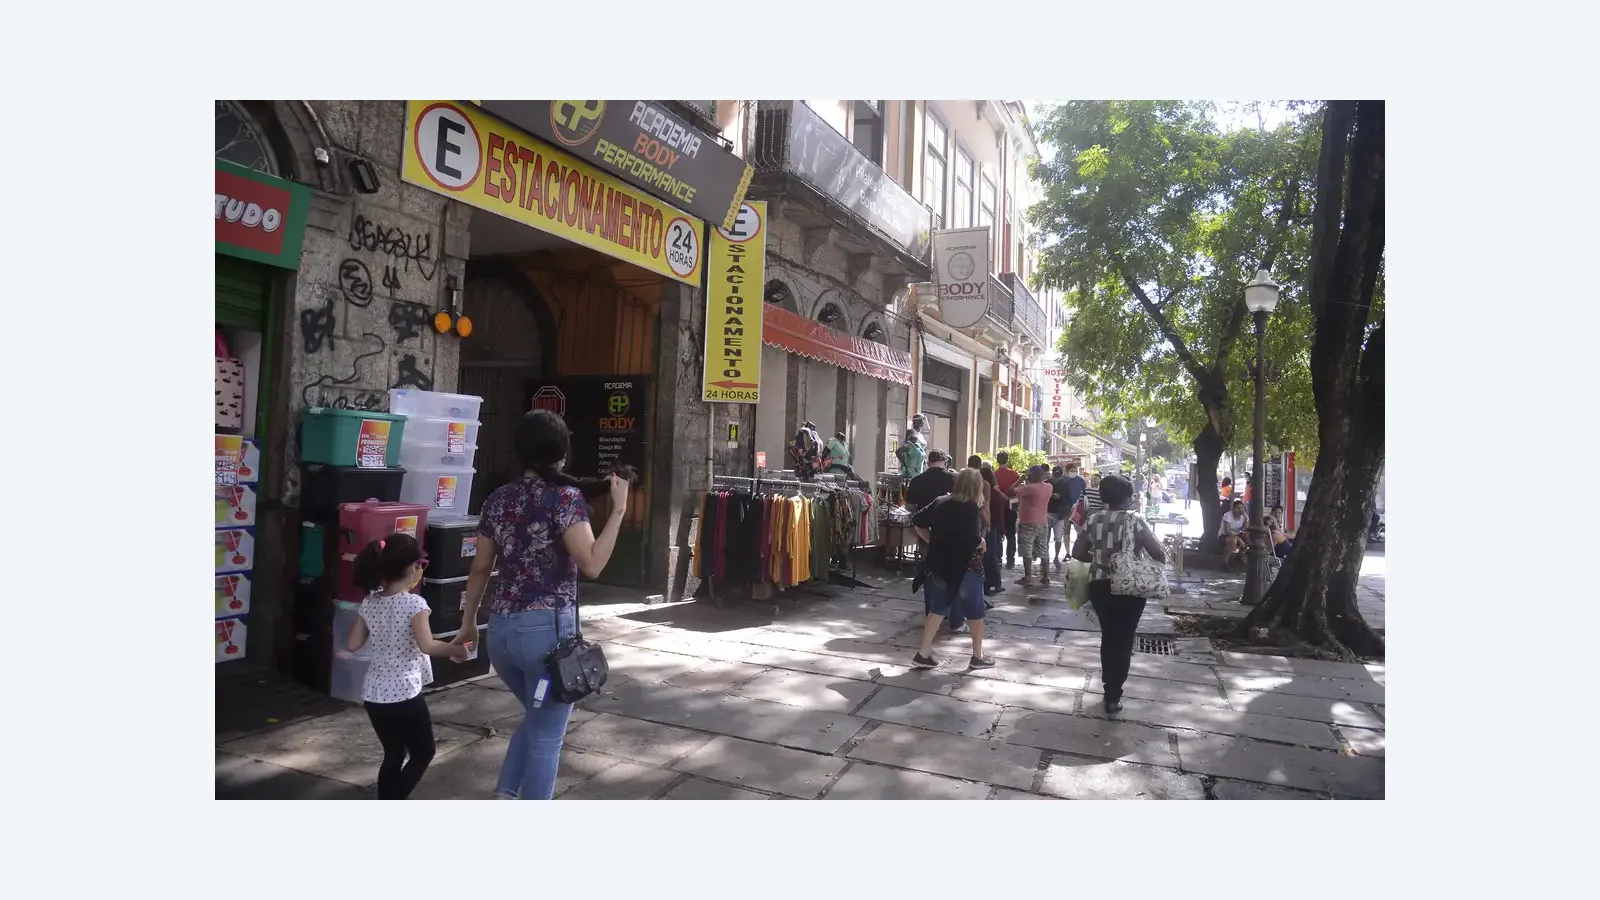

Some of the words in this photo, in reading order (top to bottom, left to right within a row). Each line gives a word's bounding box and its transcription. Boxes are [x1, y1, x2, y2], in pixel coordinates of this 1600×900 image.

[629, 100, 702, 159] ACADEMIA
[633, 132, 681, 170] BODY
[593, 138, 697, 204] PERFORMANCE
[435, 115, 466, 180] E
[484, 131, 664, 260] ESTACIONAMENTO
[672, 225, 692, 253] 24
[945, 244, 978, 252] ACADEMIA
[669, 249, 693, 269] HORAS
[939, 281, 985, 296] BODY
[604, 382, 633, 390] ACADEMIA
[706, 389, 718, 399] 24
[721, 390, 758, 400] HORAS
[1052, 378, 1062, 419] VITORIA
[599, 417, 635, 429] BODY
